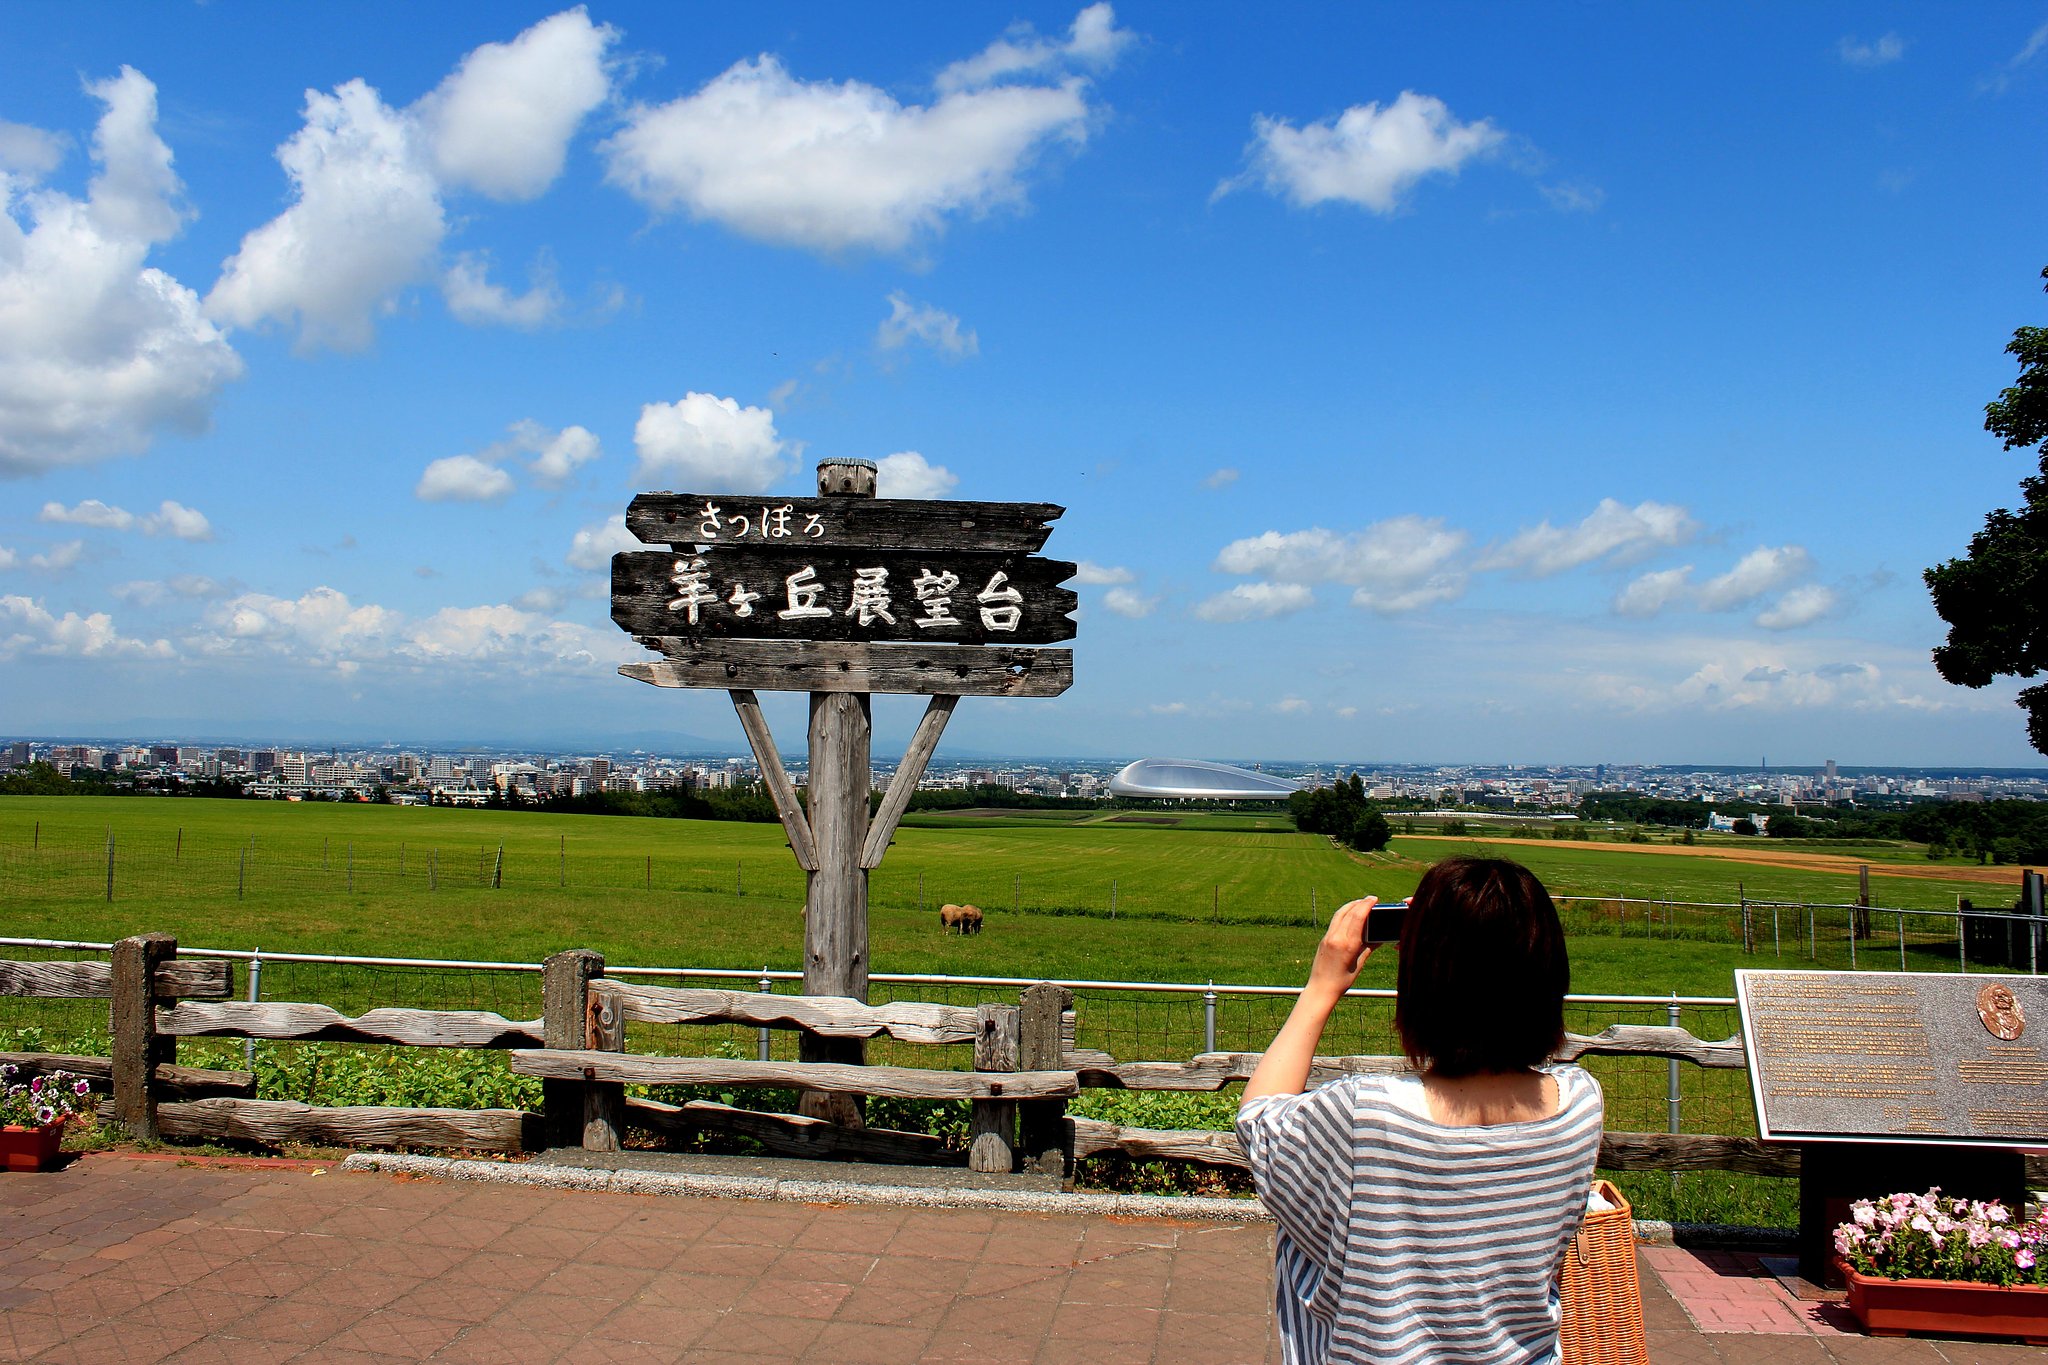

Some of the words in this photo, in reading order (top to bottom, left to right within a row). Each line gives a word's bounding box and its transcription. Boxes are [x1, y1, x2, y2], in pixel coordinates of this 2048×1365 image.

[699, 501, 826, 539] さっぽろ
[667, 557, 1023, 632] 羊ヶ丘展望台
